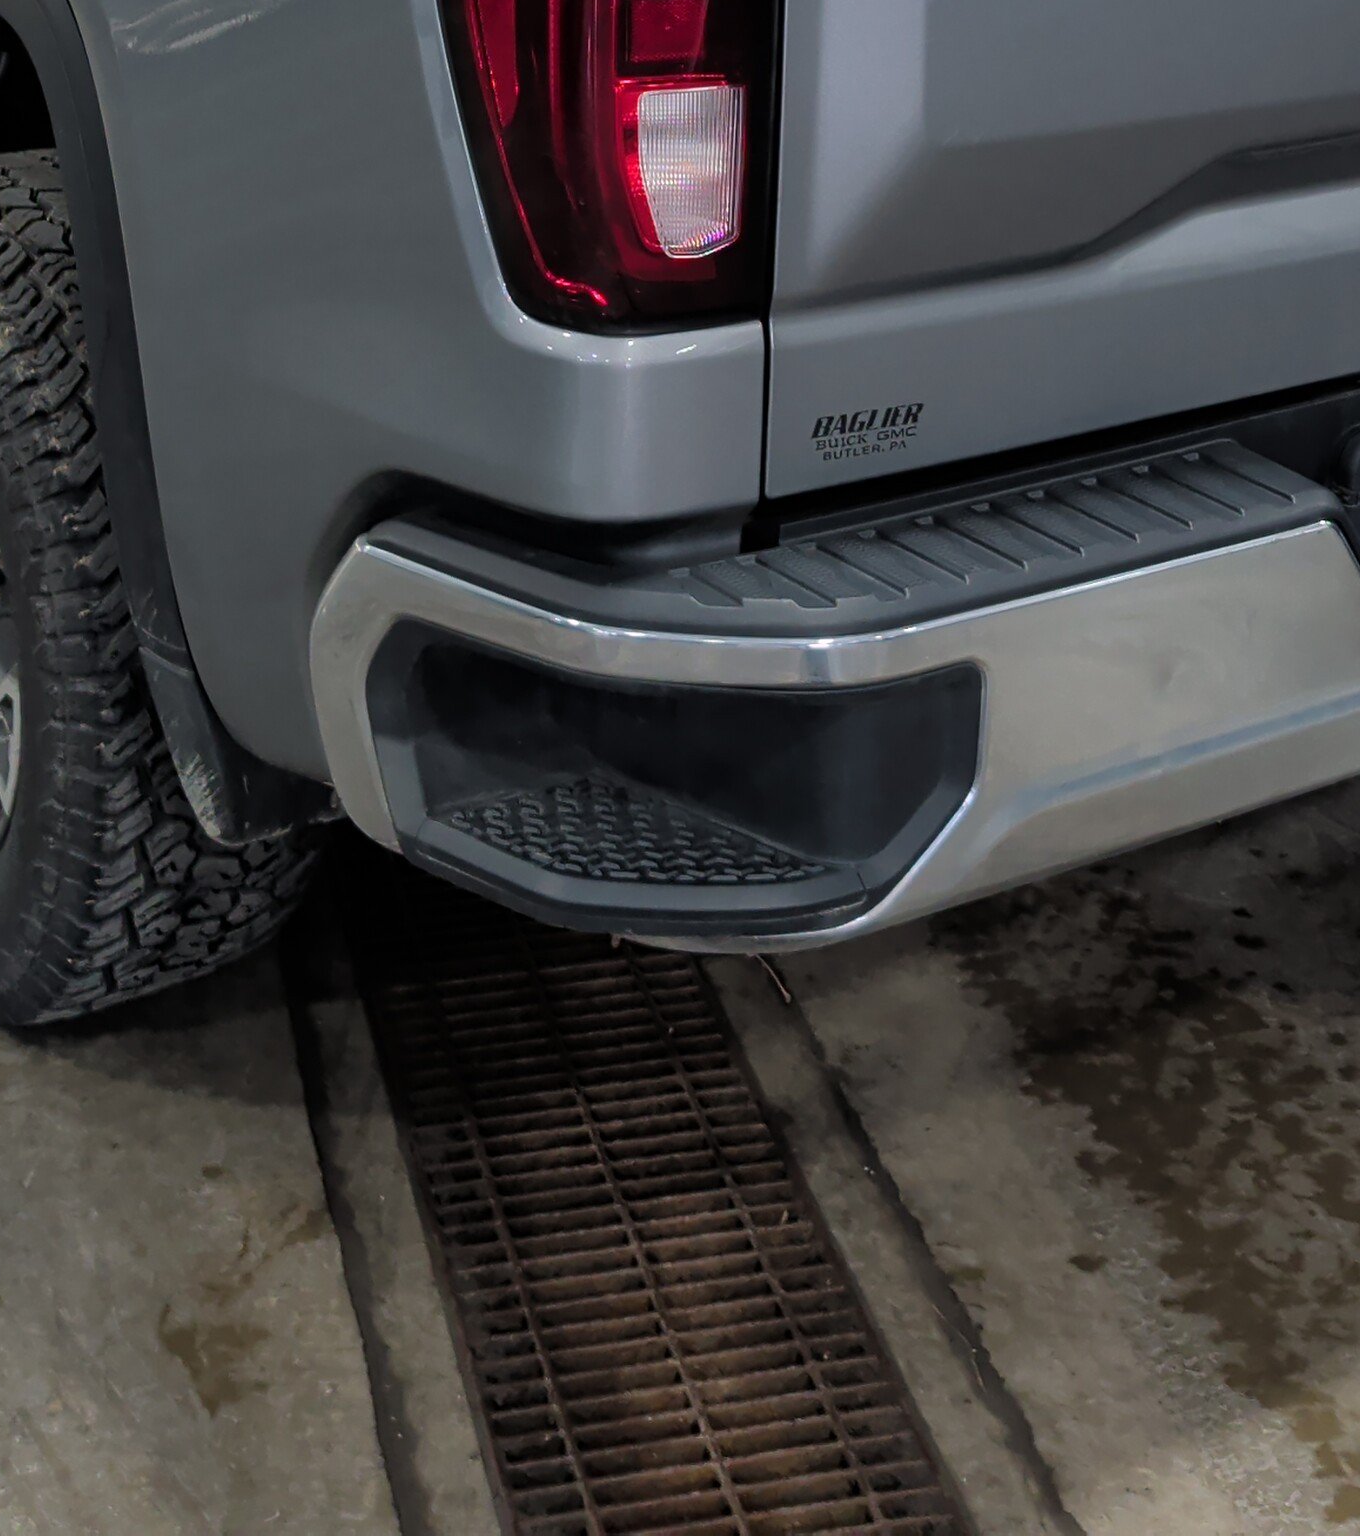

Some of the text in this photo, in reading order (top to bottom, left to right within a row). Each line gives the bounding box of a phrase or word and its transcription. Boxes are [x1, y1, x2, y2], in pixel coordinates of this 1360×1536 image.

[811, 402, 924, 439] BAGLIER
[815, 426, 917, 452] BUICK GMC
[889, 440, 907, 451] PA
